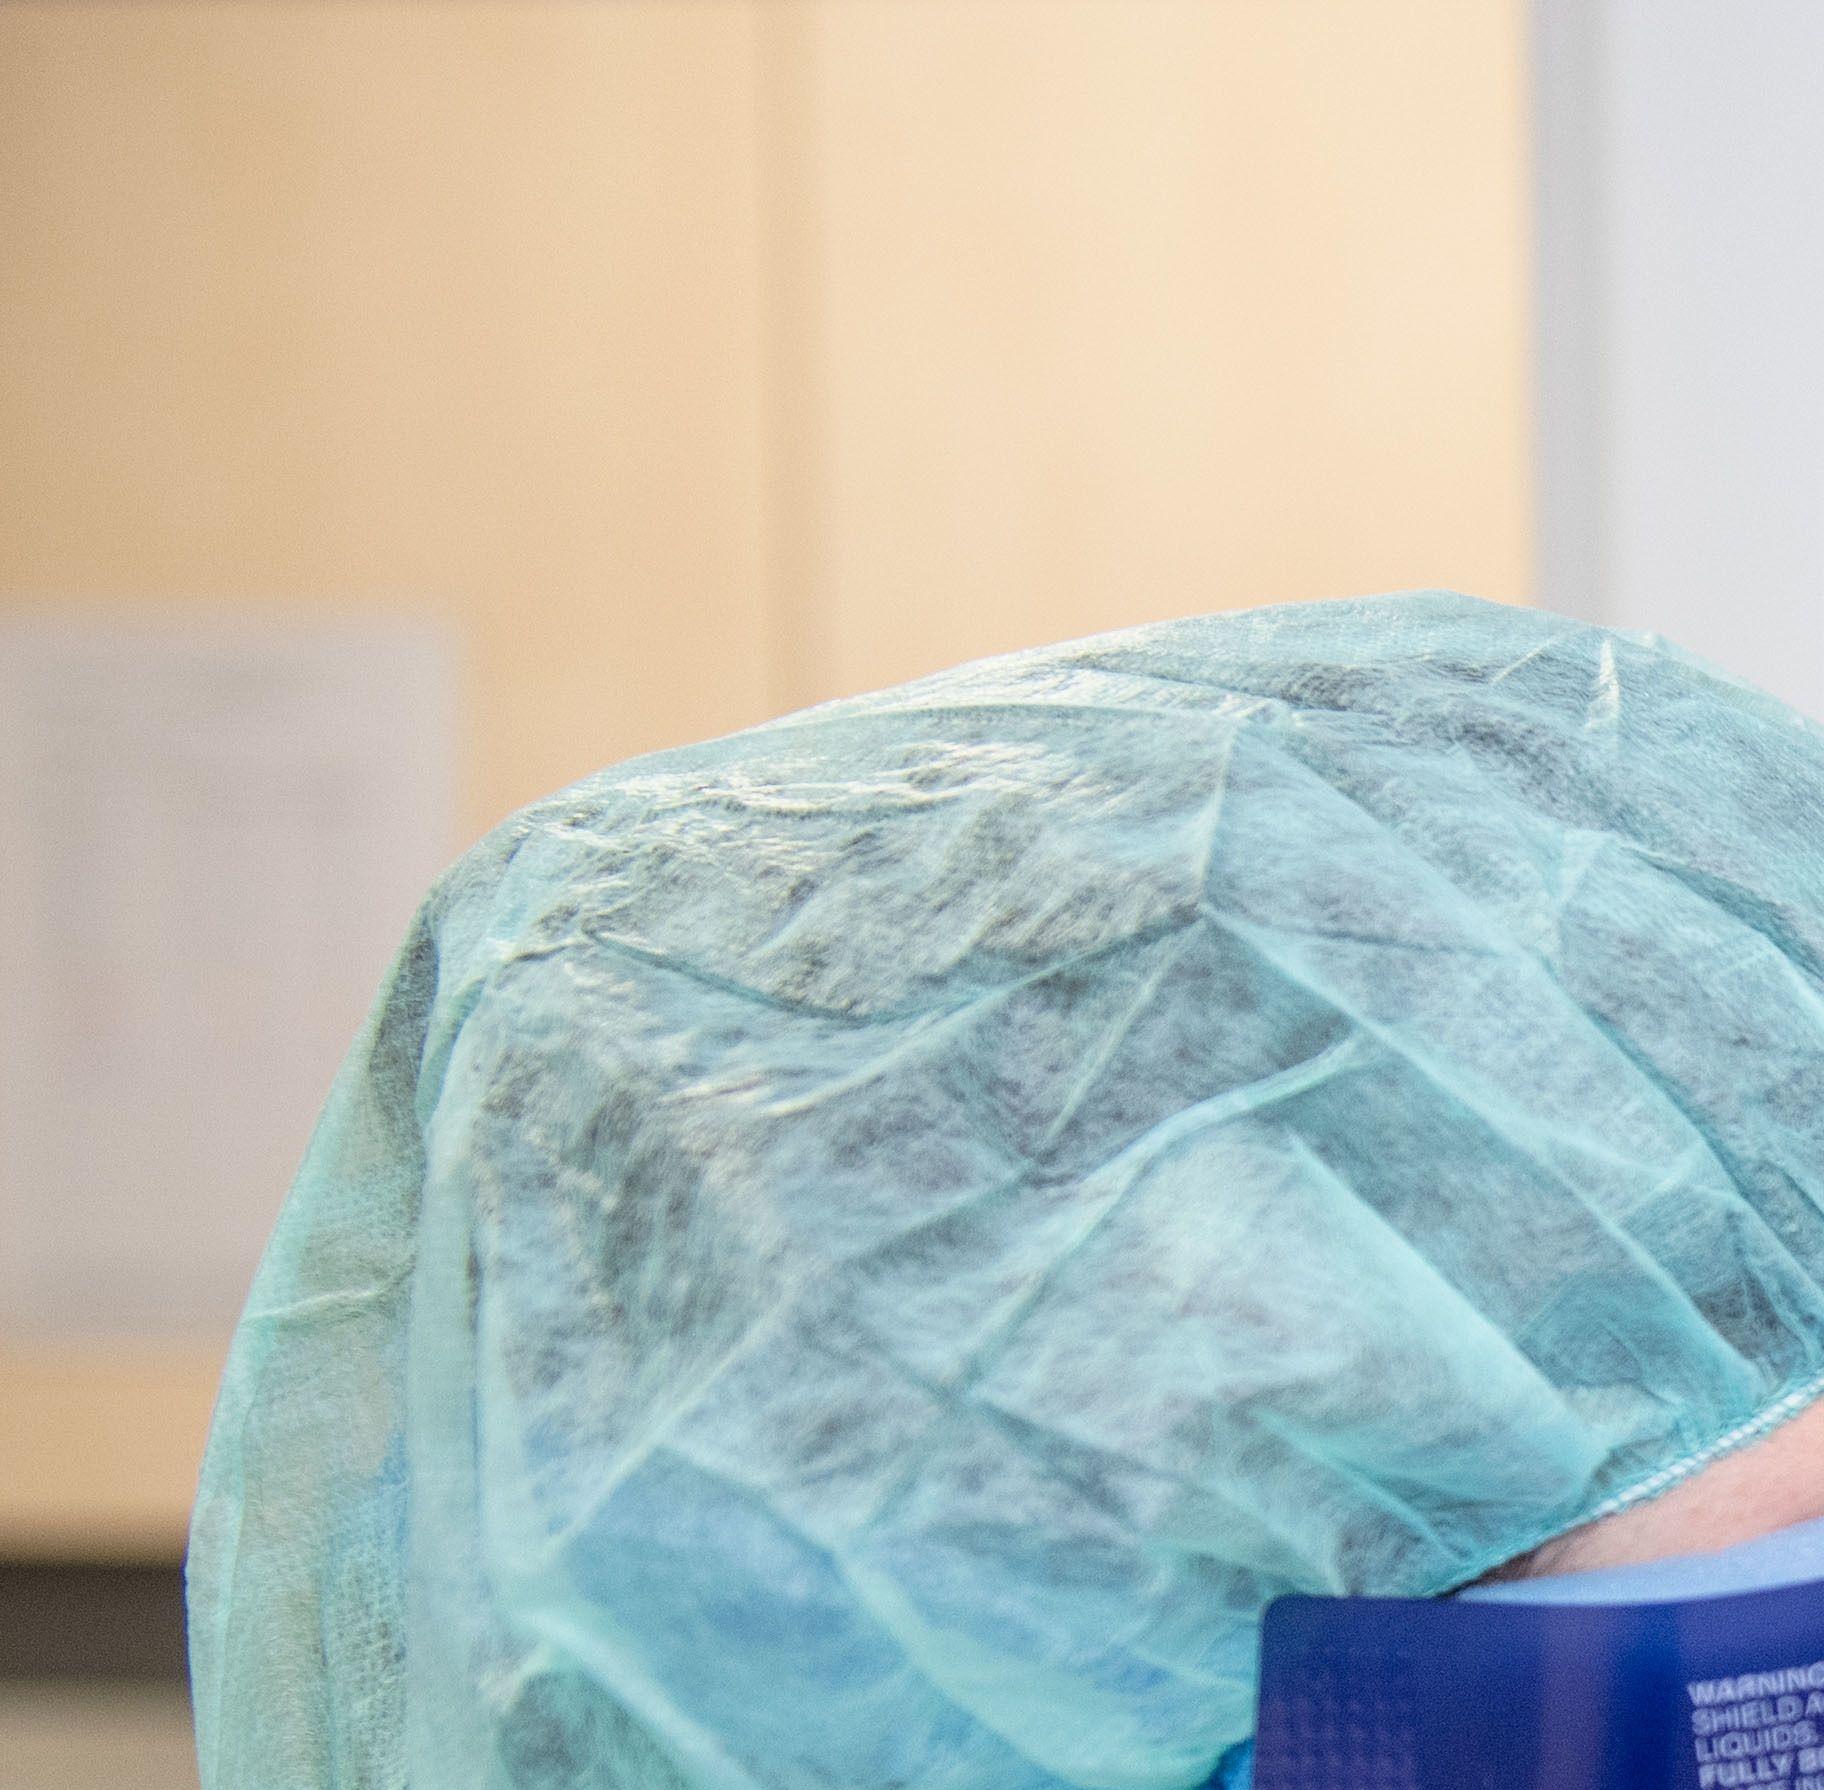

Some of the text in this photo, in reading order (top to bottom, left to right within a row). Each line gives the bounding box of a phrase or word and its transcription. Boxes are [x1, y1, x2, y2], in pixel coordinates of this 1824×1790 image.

[1692, 1696, 1803, 1737] SHIELD
[1695, 1720, 1823, 1763] LIQUIDS.
[1698, 1752, 1794, 1789] FULLY
